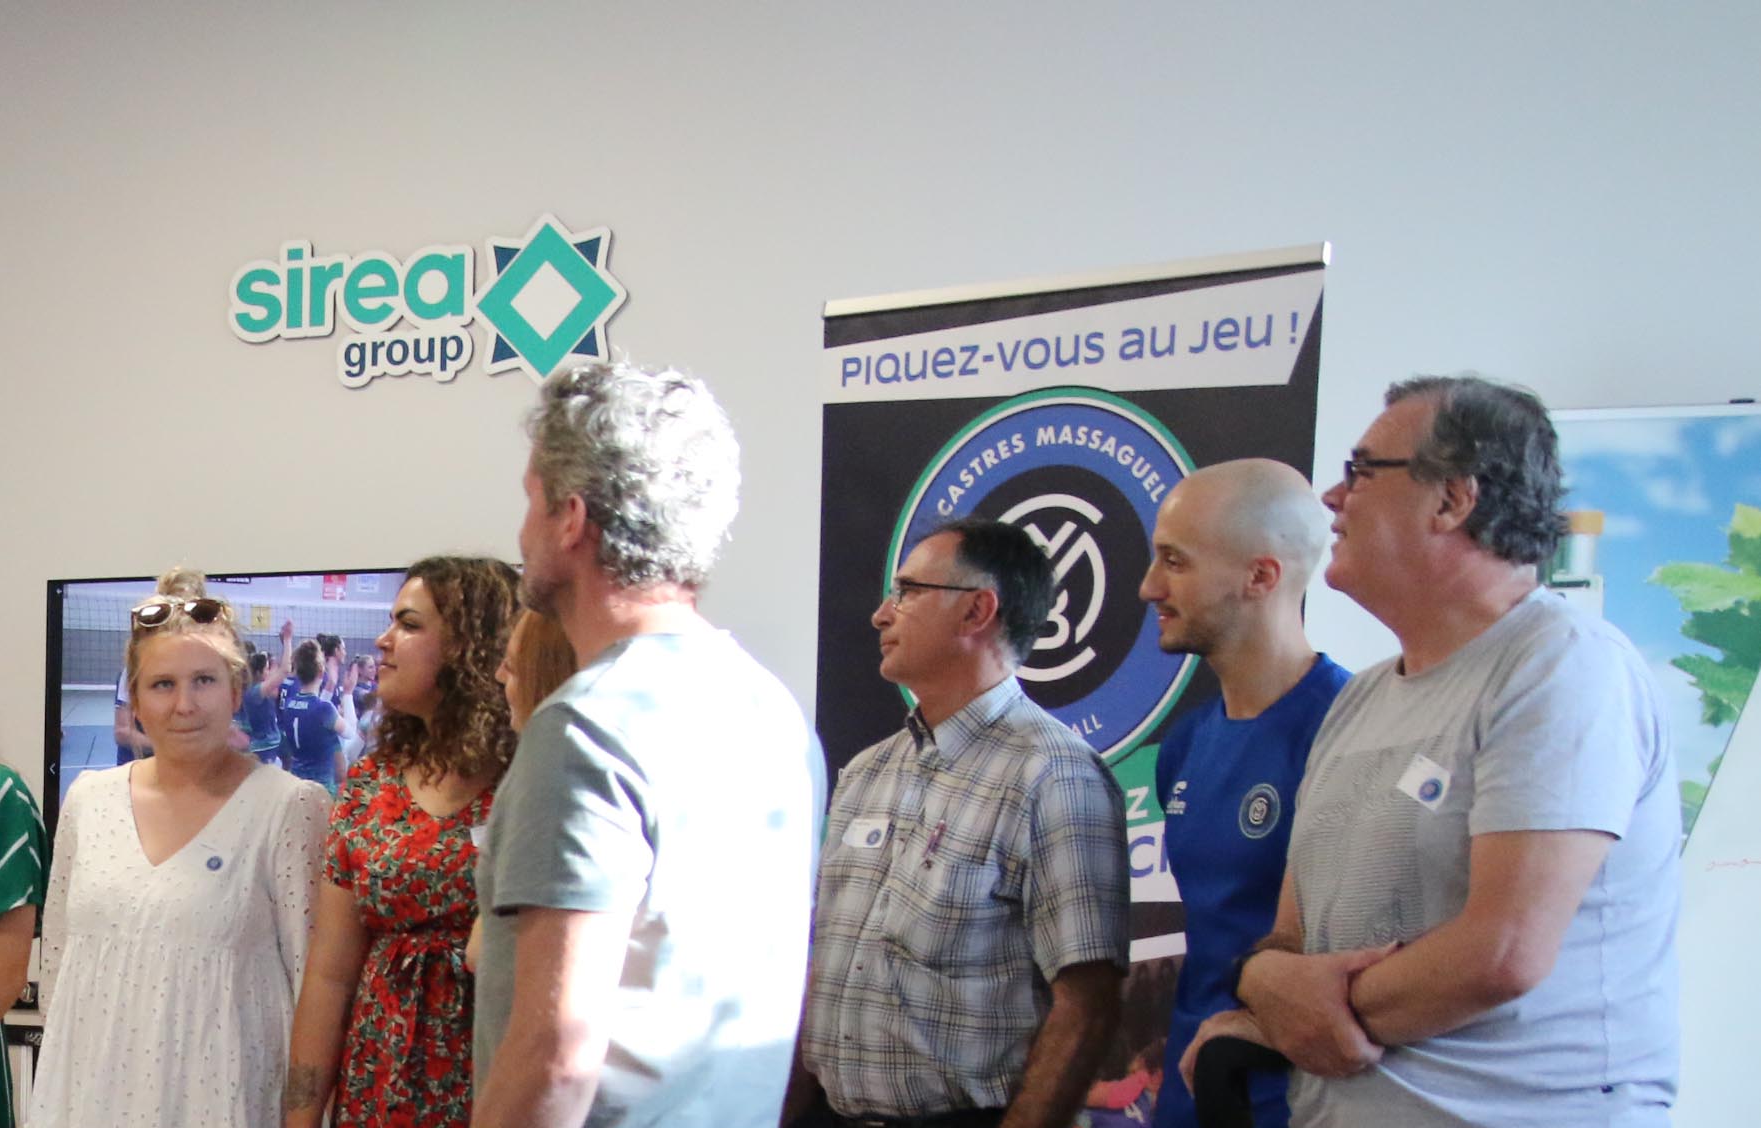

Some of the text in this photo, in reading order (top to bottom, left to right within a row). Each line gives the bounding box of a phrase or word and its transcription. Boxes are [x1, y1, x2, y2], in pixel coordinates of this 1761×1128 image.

[234, 248, 466, 333] sirea
[343, 334, 464, 378] group
[1118, 320, 1176, 362] au
[1288, 311, 1300, 344] !
[937, 424, 1168, 516] CASTRES MASSAGUEL
